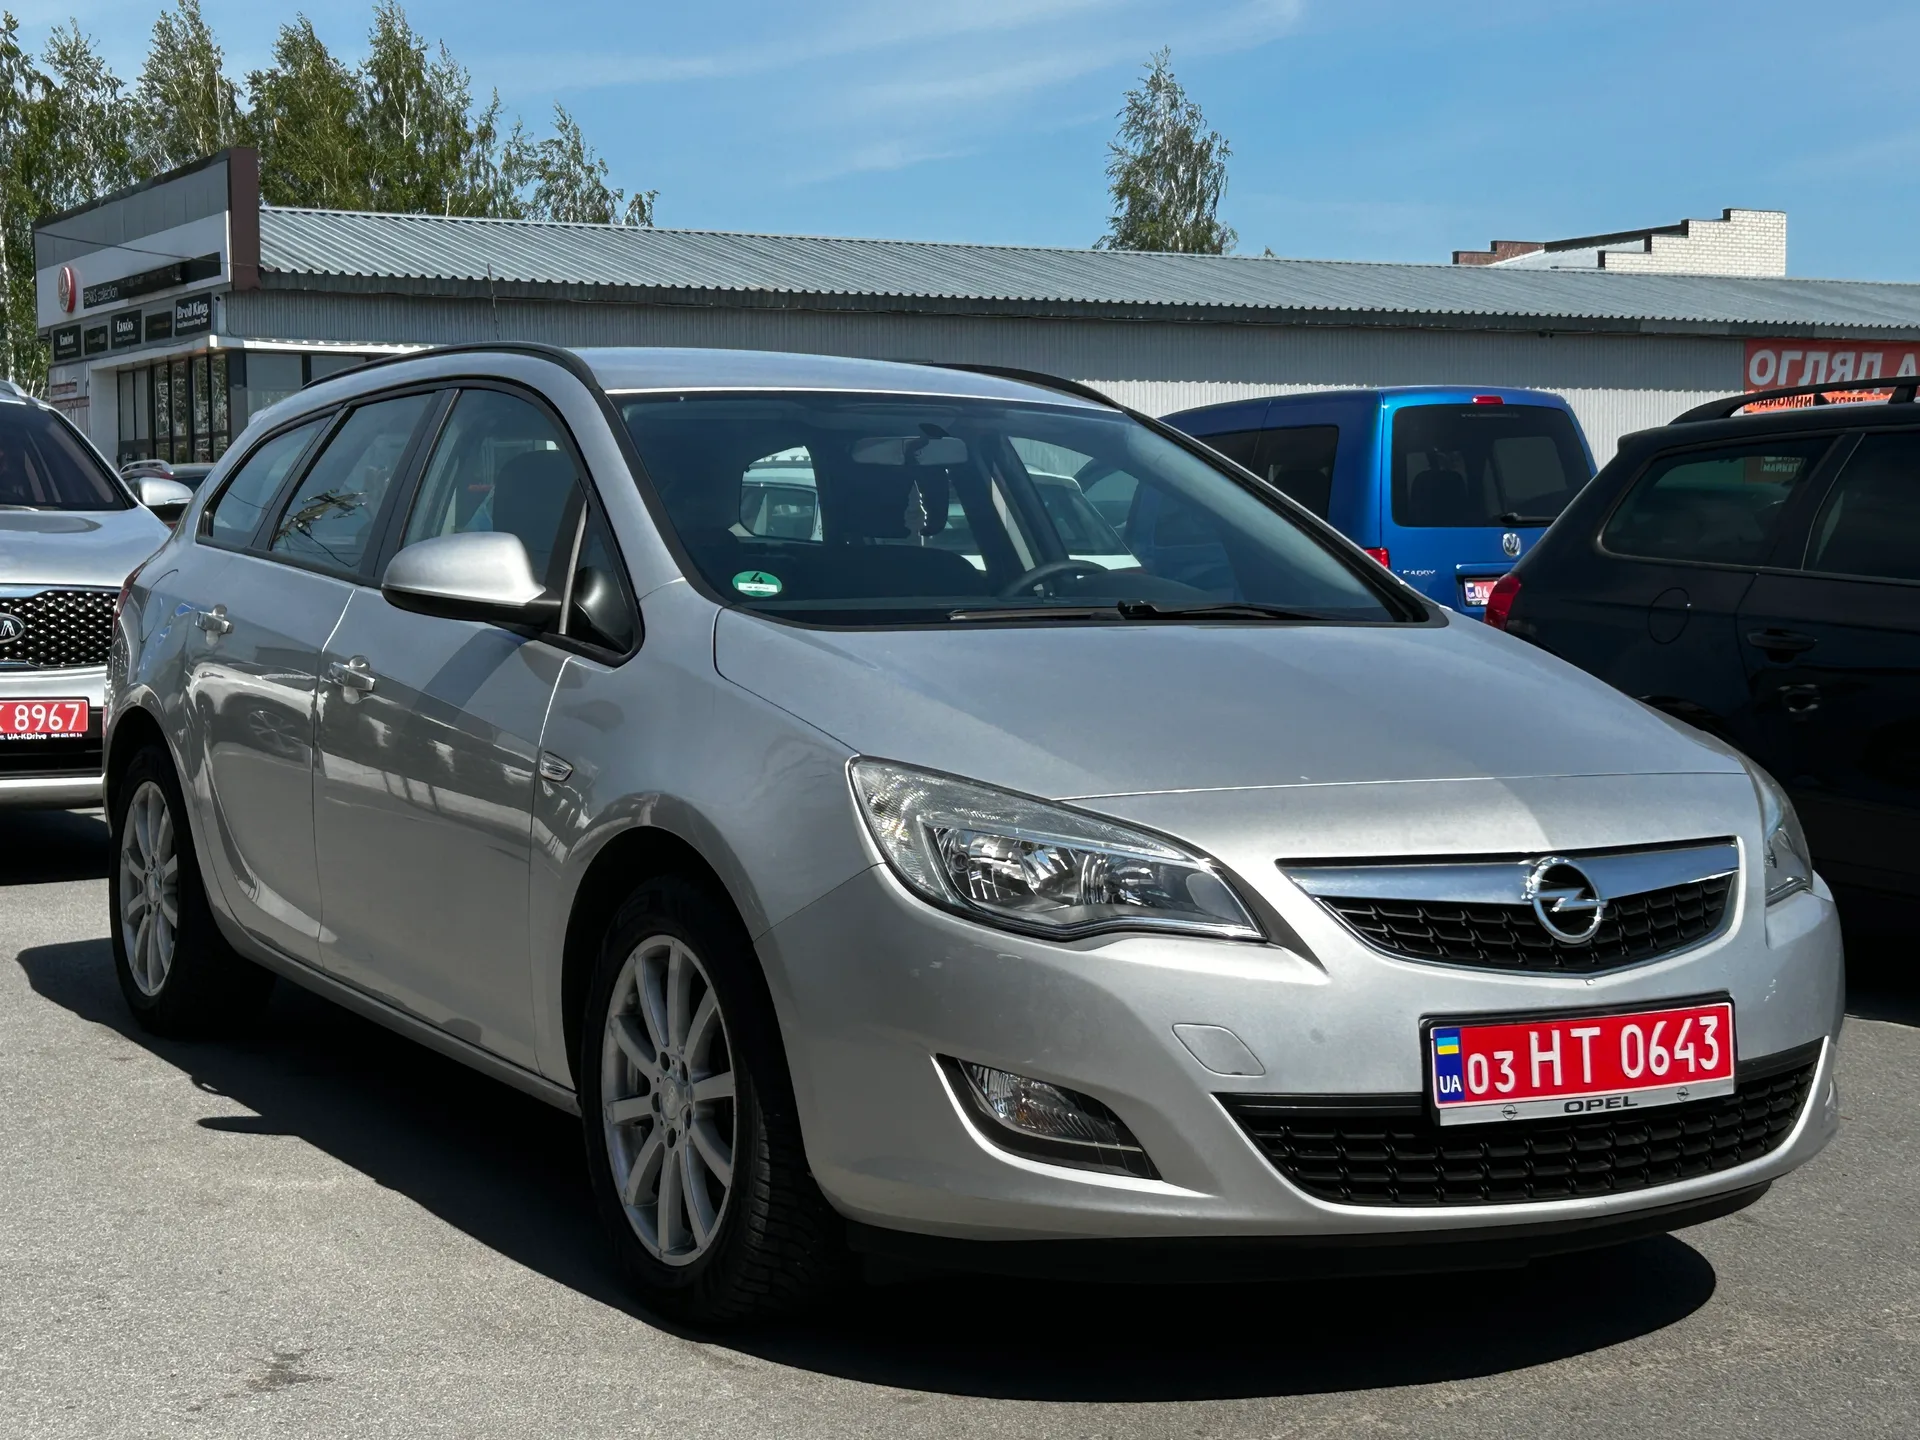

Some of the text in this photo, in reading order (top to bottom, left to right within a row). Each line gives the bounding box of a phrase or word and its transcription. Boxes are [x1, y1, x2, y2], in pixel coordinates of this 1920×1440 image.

[15, 704, 80, 732] 8967
[1467, 1050, 1516, 1095] 03
[1620, 1015, 1719, 1079] 0643
[1439, 1074, 1462, 1094] UA
[1564, 1095, 1638, 1113] OPEL
